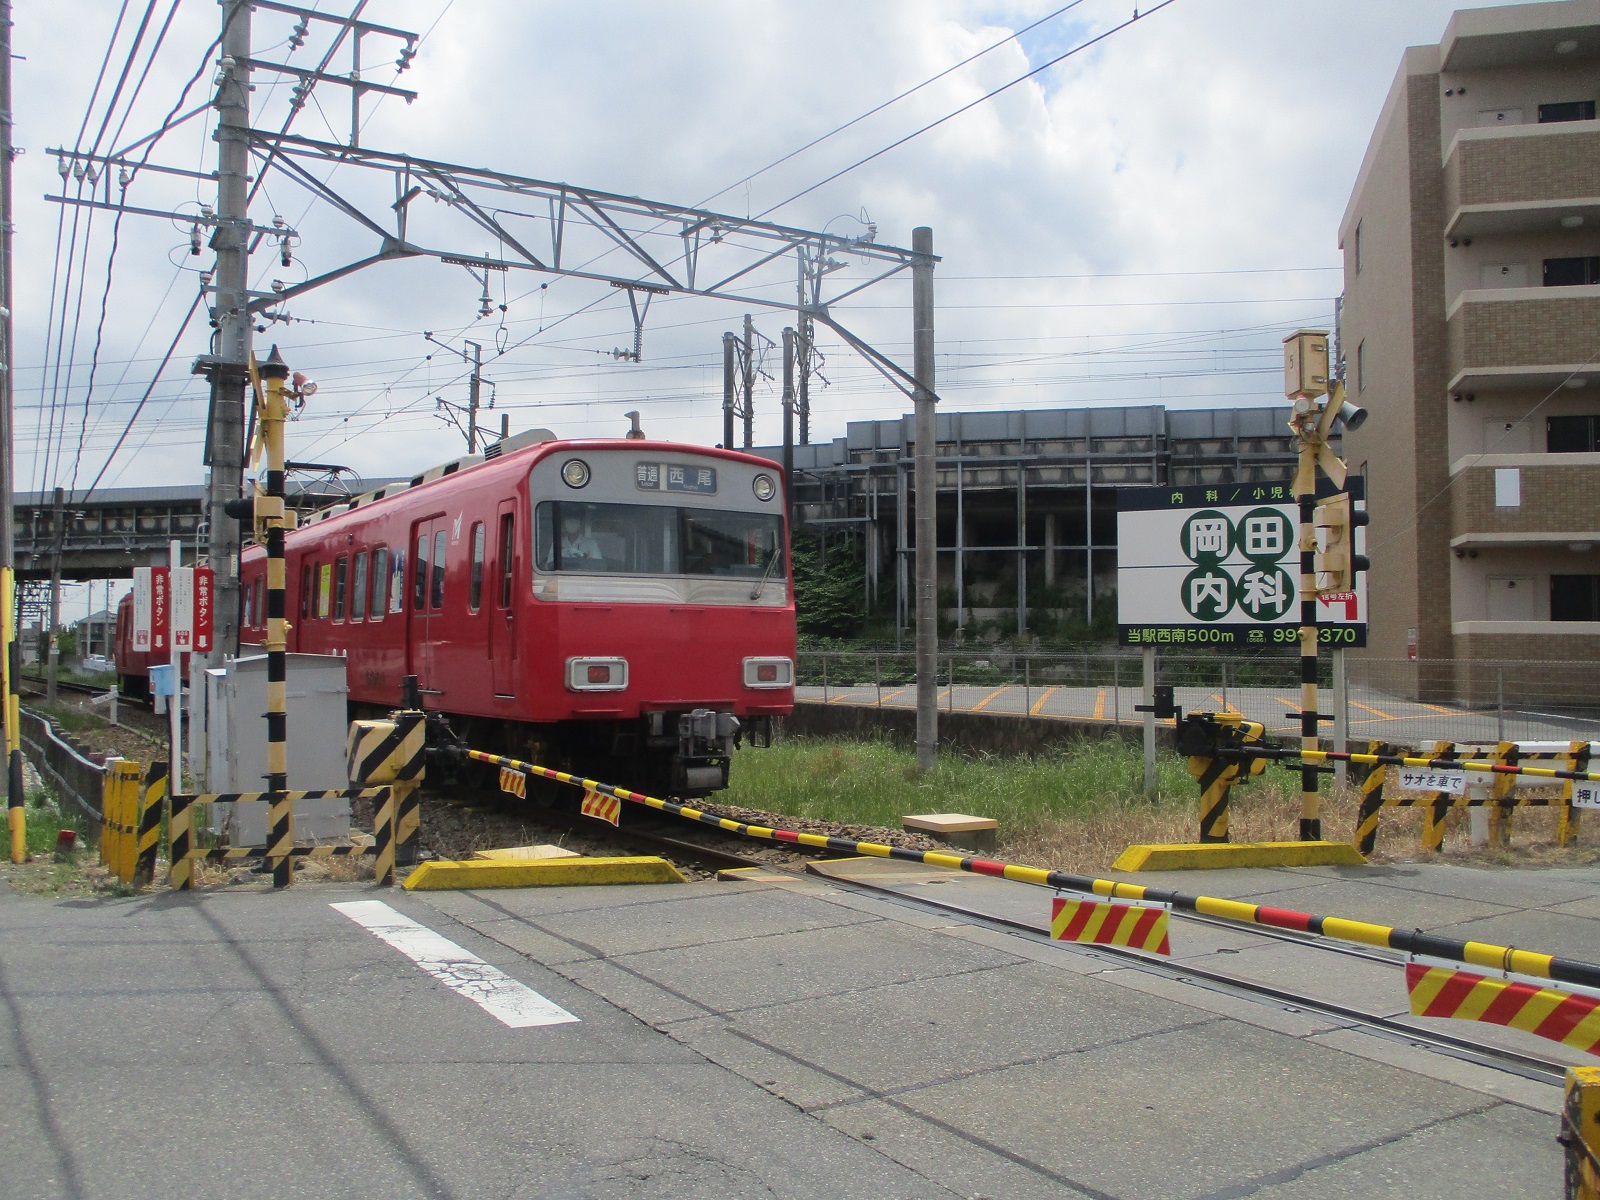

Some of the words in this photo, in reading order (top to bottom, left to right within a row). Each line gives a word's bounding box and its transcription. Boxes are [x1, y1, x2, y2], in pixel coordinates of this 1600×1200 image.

[637, 465, 658, 482] 普通
[669, 467, 712, 486] 西尾
[1189, 516, 1284, 558] 岡田
[155, 574, 165, 627] 非常ボタン
[198, 575, 208, 627] 非常ボタン
[1190, 571, 1287, 614] 内科
[1128, 628, 1235, 643] 当駅西南500m
[1403, 773, 1463, 789] サオを車で
